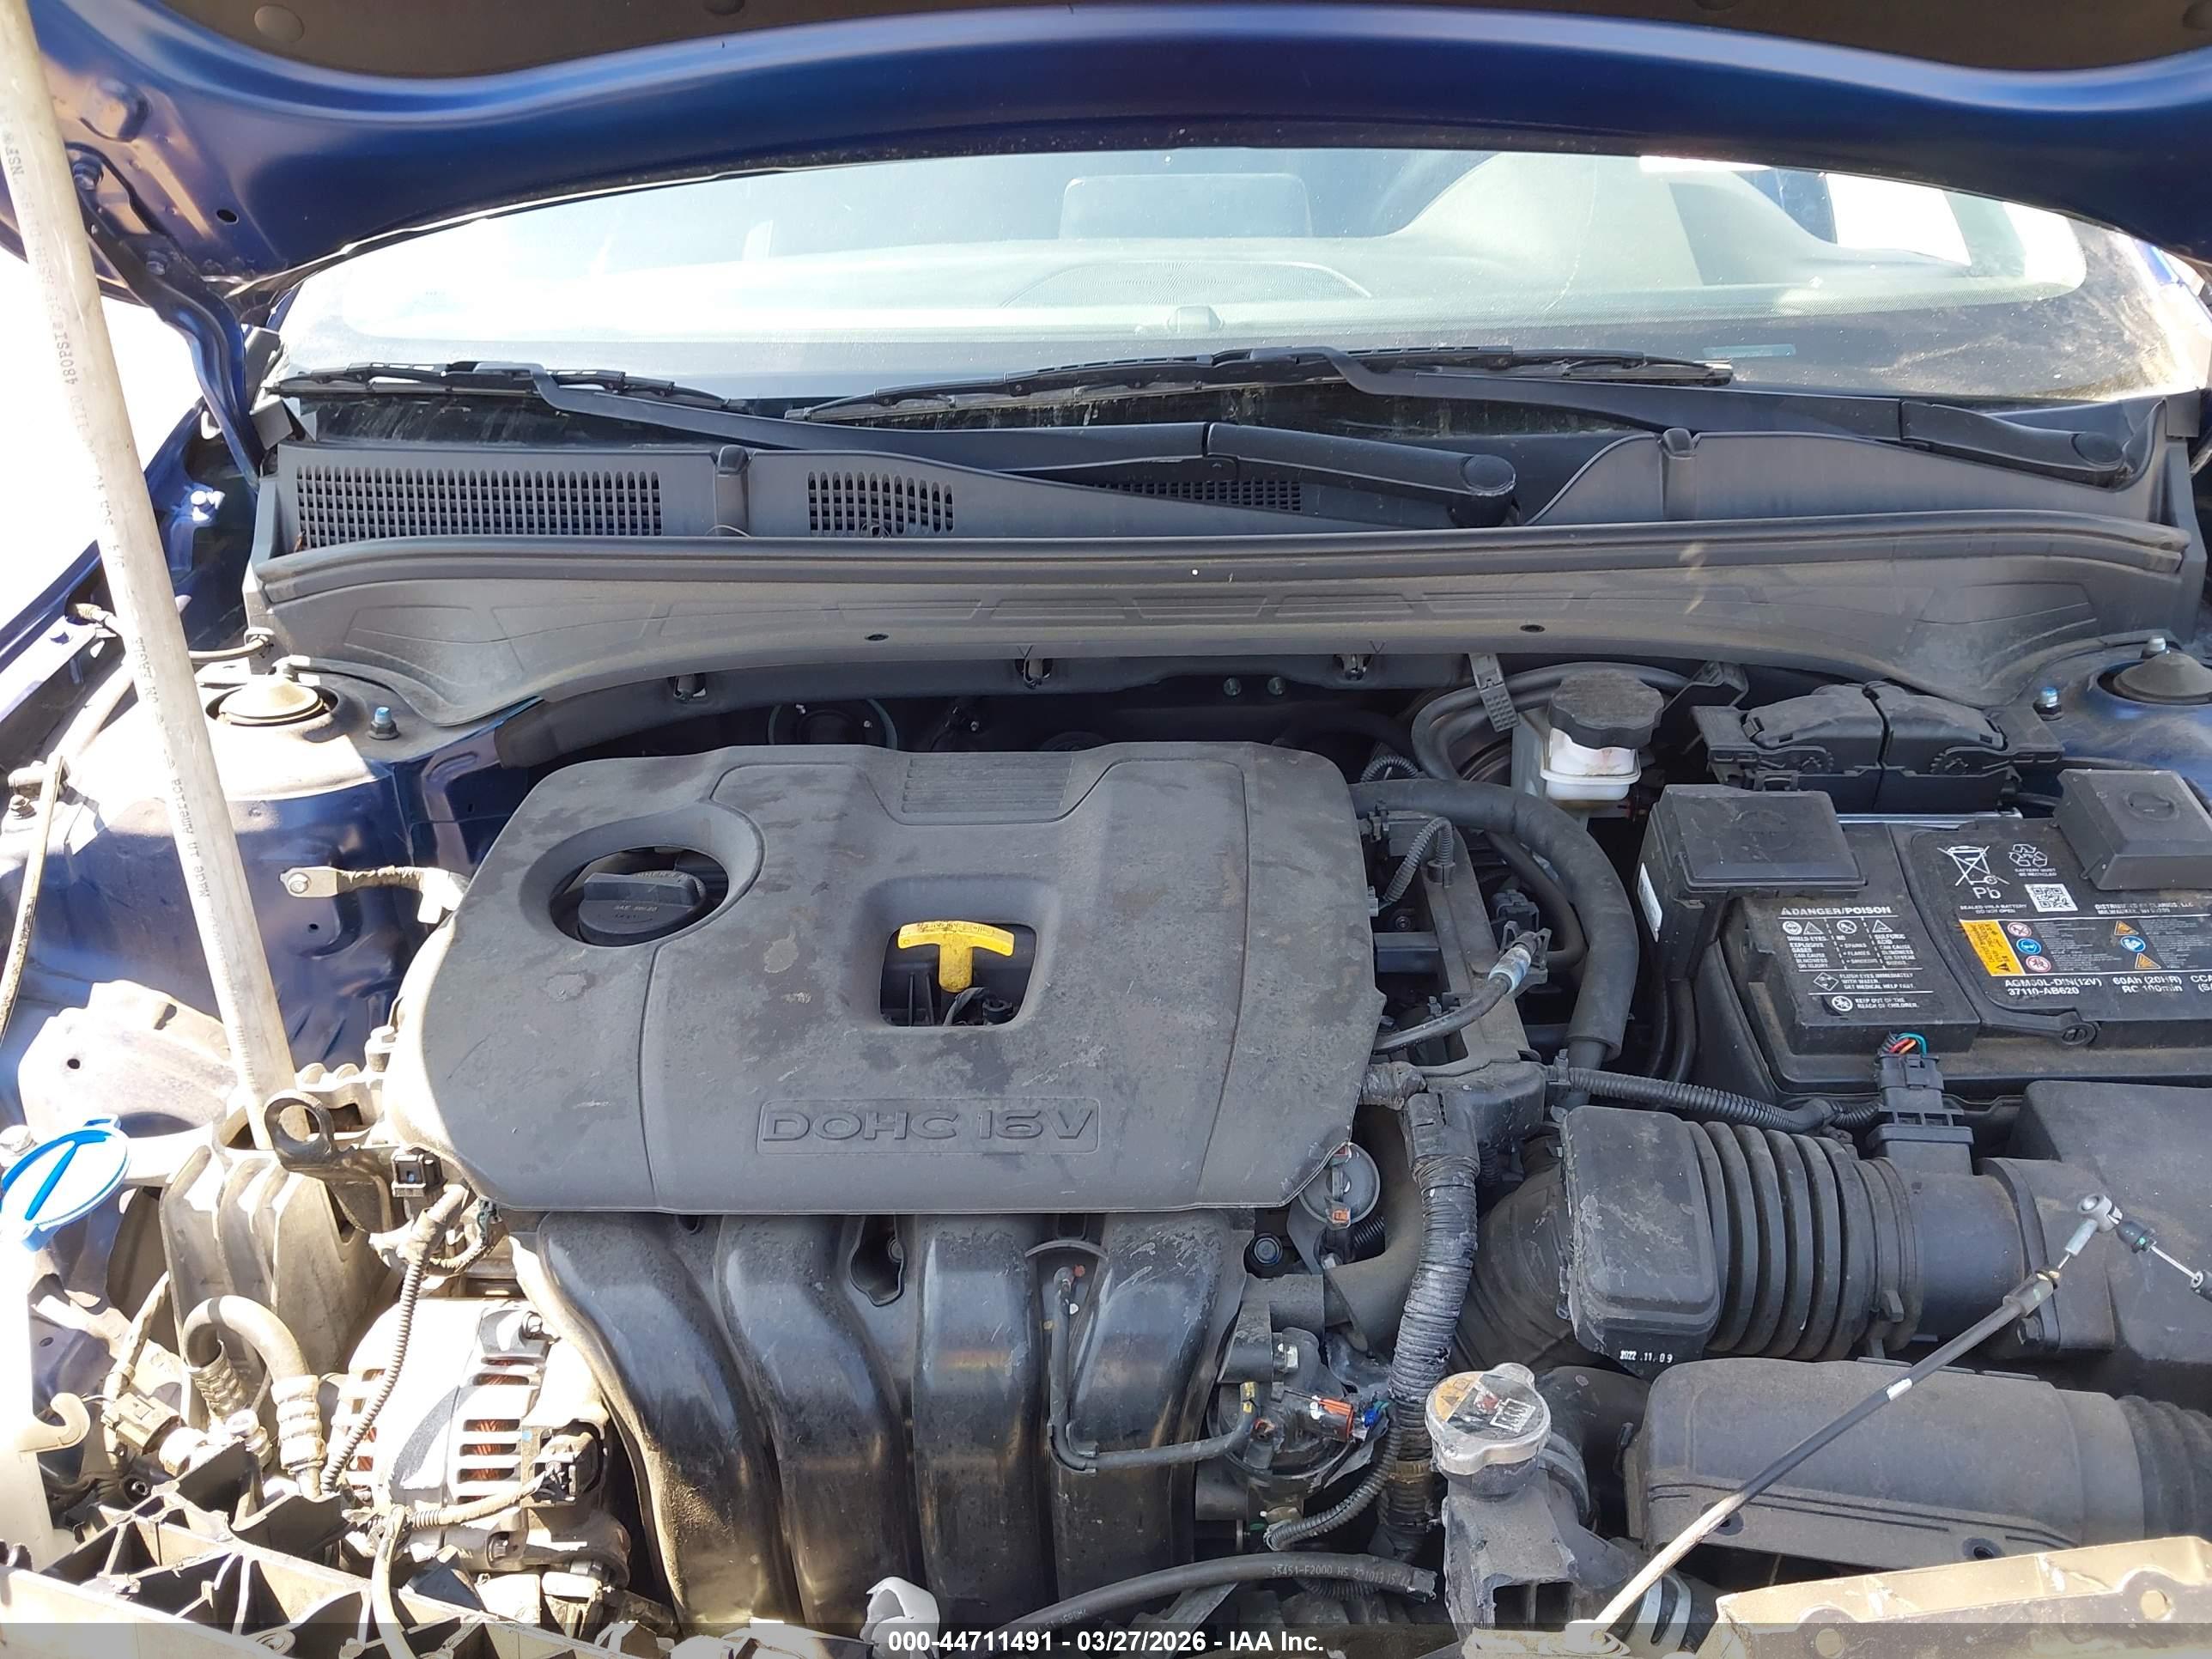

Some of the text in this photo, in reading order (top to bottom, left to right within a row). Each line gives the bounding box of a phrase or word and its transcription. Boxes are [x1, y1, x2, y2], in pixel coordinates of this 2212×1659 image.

[131, 635, 153, 681] EAGLE
[169, 777, 194, 836] America
[185, 841, 199, 859] in
[191, 864, 210, 899] Made
[1972, 887, 2002, 899] Pb
[1792, 907, 1892, 915] DANGER/POISON
[2112, 976, 2142, 985] 60Ah
[2007, 987, 2080, 996] 37110-AB620
[762, 1109, 1093, 1141] DOHC 16V
